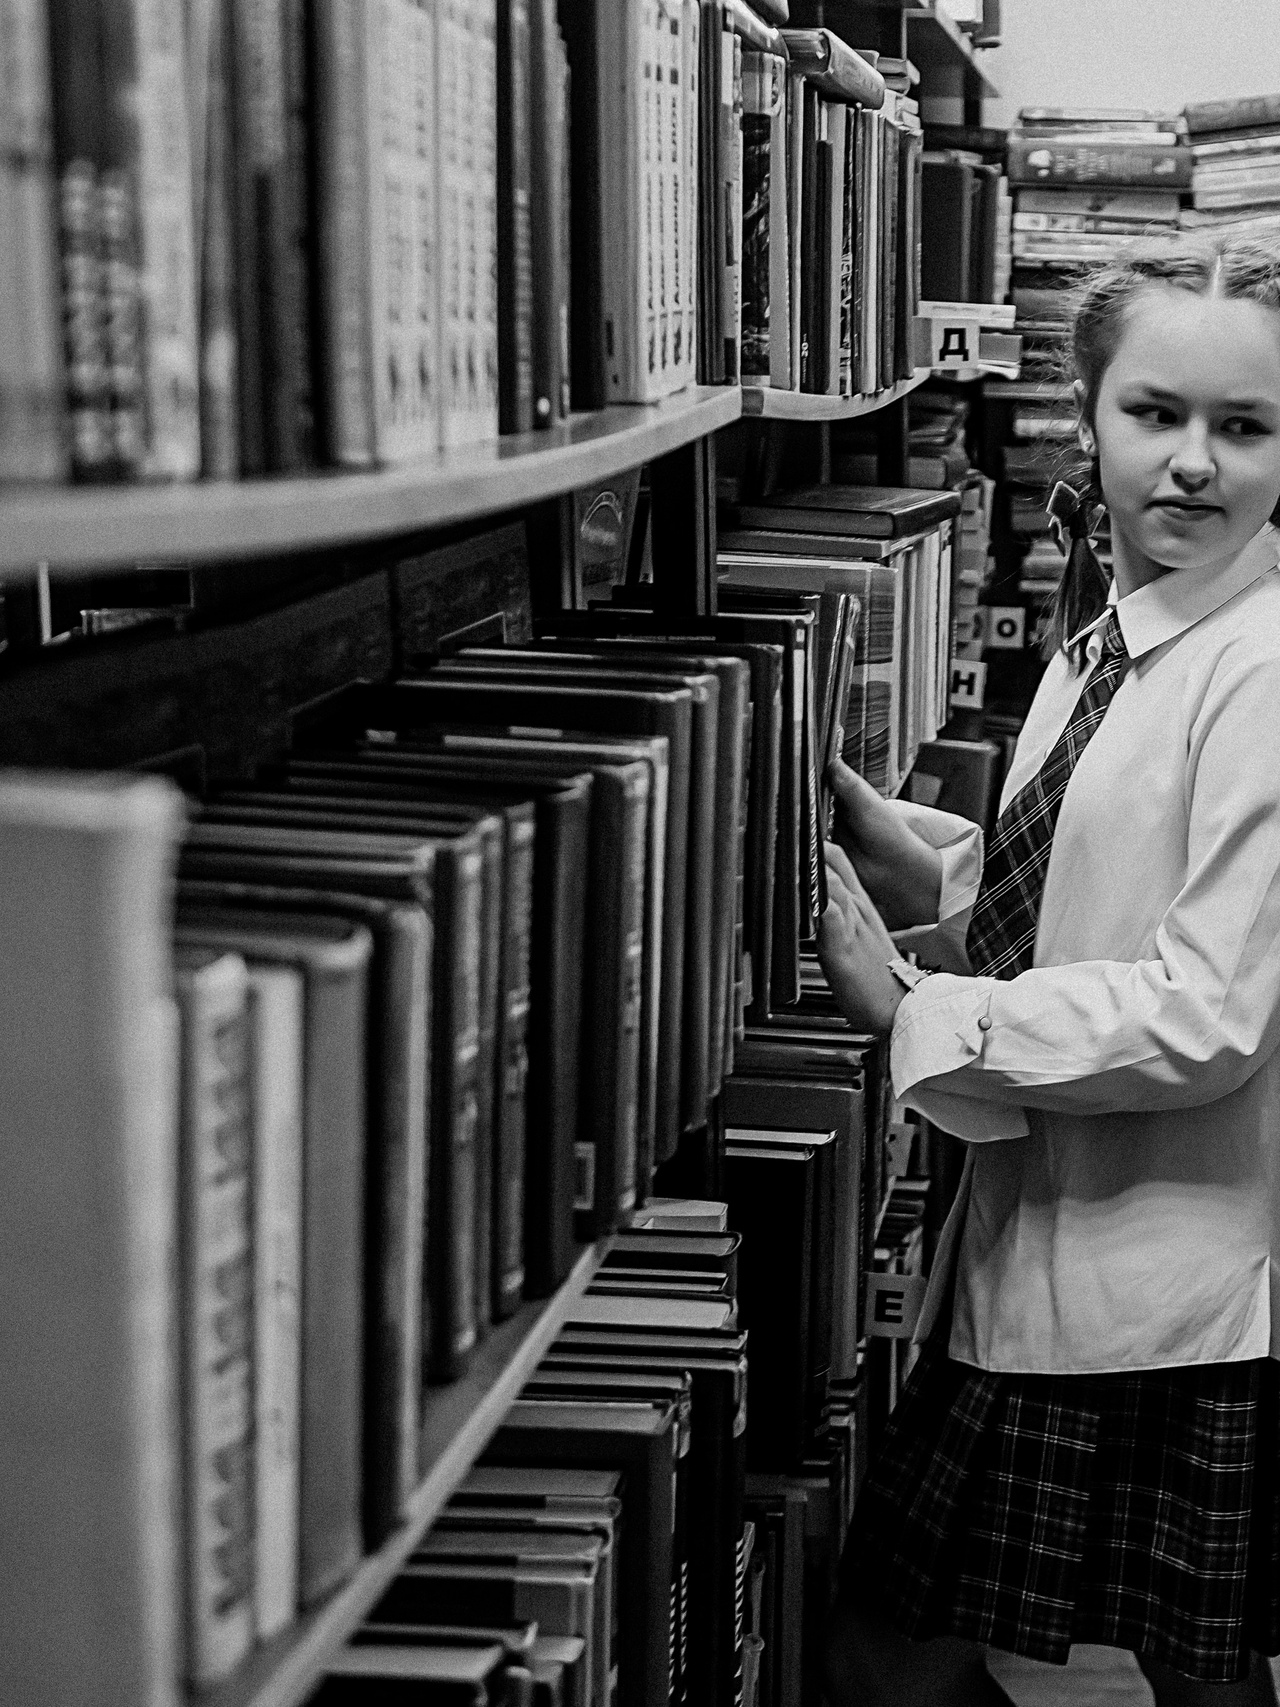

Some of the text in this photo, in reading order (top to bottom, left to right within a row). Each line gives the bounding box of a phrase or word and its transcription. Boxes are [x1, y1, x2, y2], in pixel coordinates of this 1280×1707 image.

[939, 327, 969, 362] Д
[997, 618, 1017, 638] О
[951, 669, 976, 696] Н
[874, 1289, 905, 1324] Е
